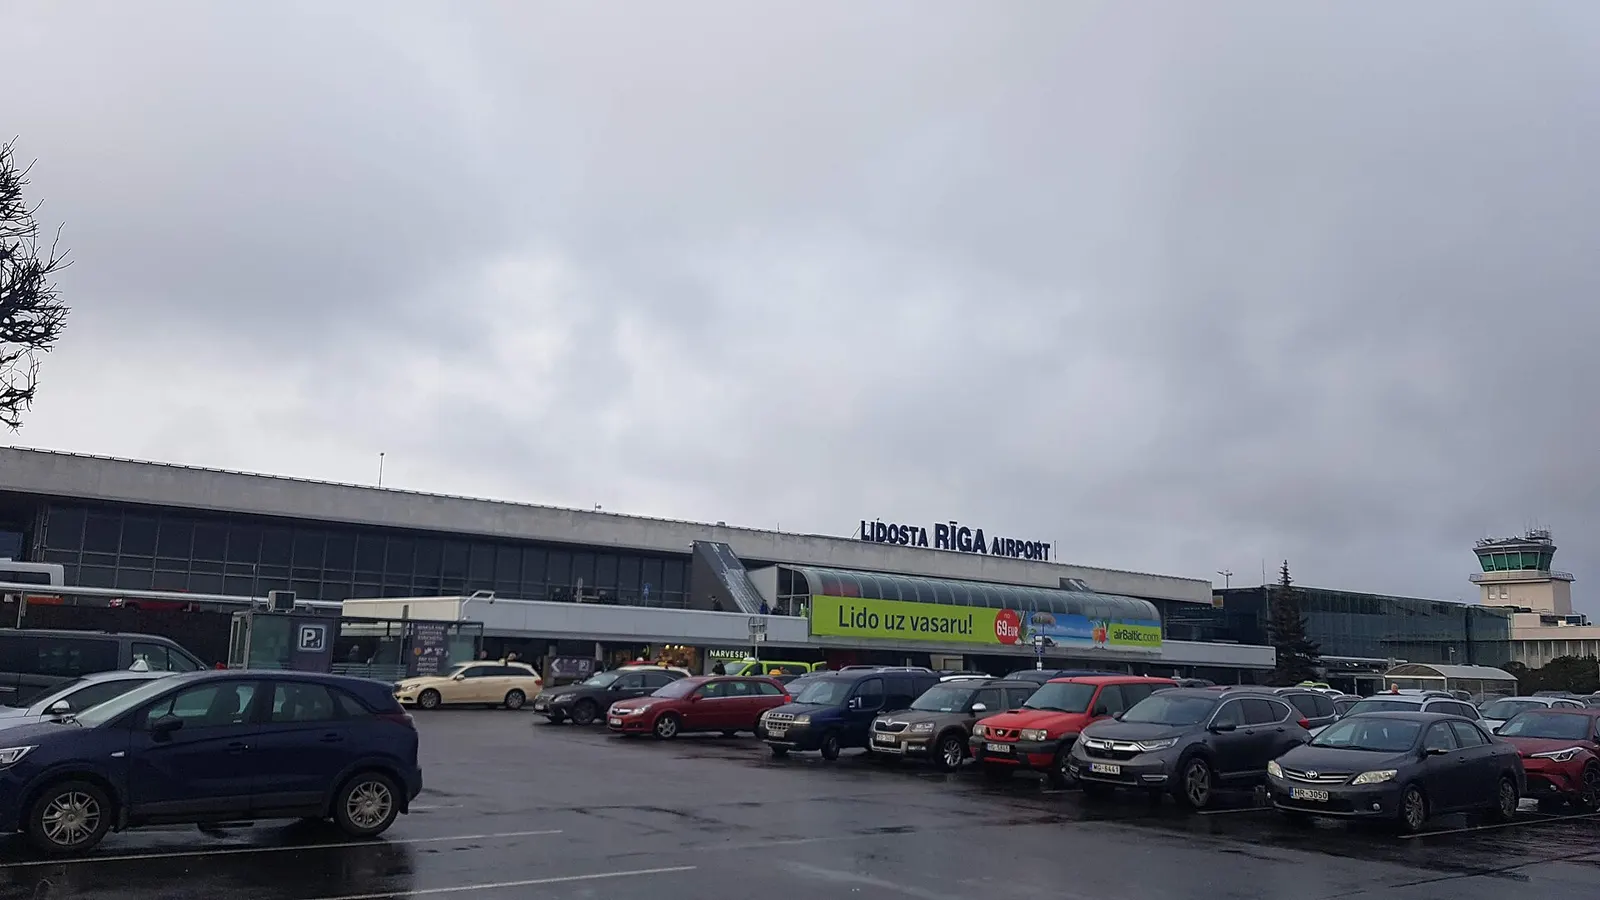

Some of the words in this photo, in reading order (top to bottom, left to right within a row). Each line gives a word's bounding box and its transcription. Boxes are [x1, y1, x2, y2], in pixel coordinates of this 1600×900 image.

[860, 520, 929, 547] LIDOSTA
[934, 521, 987, 554] RĪGA
[991, 536, 1051, 561] AIRPORT
[838, 605, 879, 629] Lido
[884, 613, 905, 630] uz
[909, 614, 973, 635] vasaru!
[996, 620, 1008, 636] 69
[1008, 626, 1018, 637] EUR
[1113, 629, 1159, 642] airBaltic.com
[709, 649, 750, 658] NARVESEN
[1294, 788, 1328, 800] HR-3050
